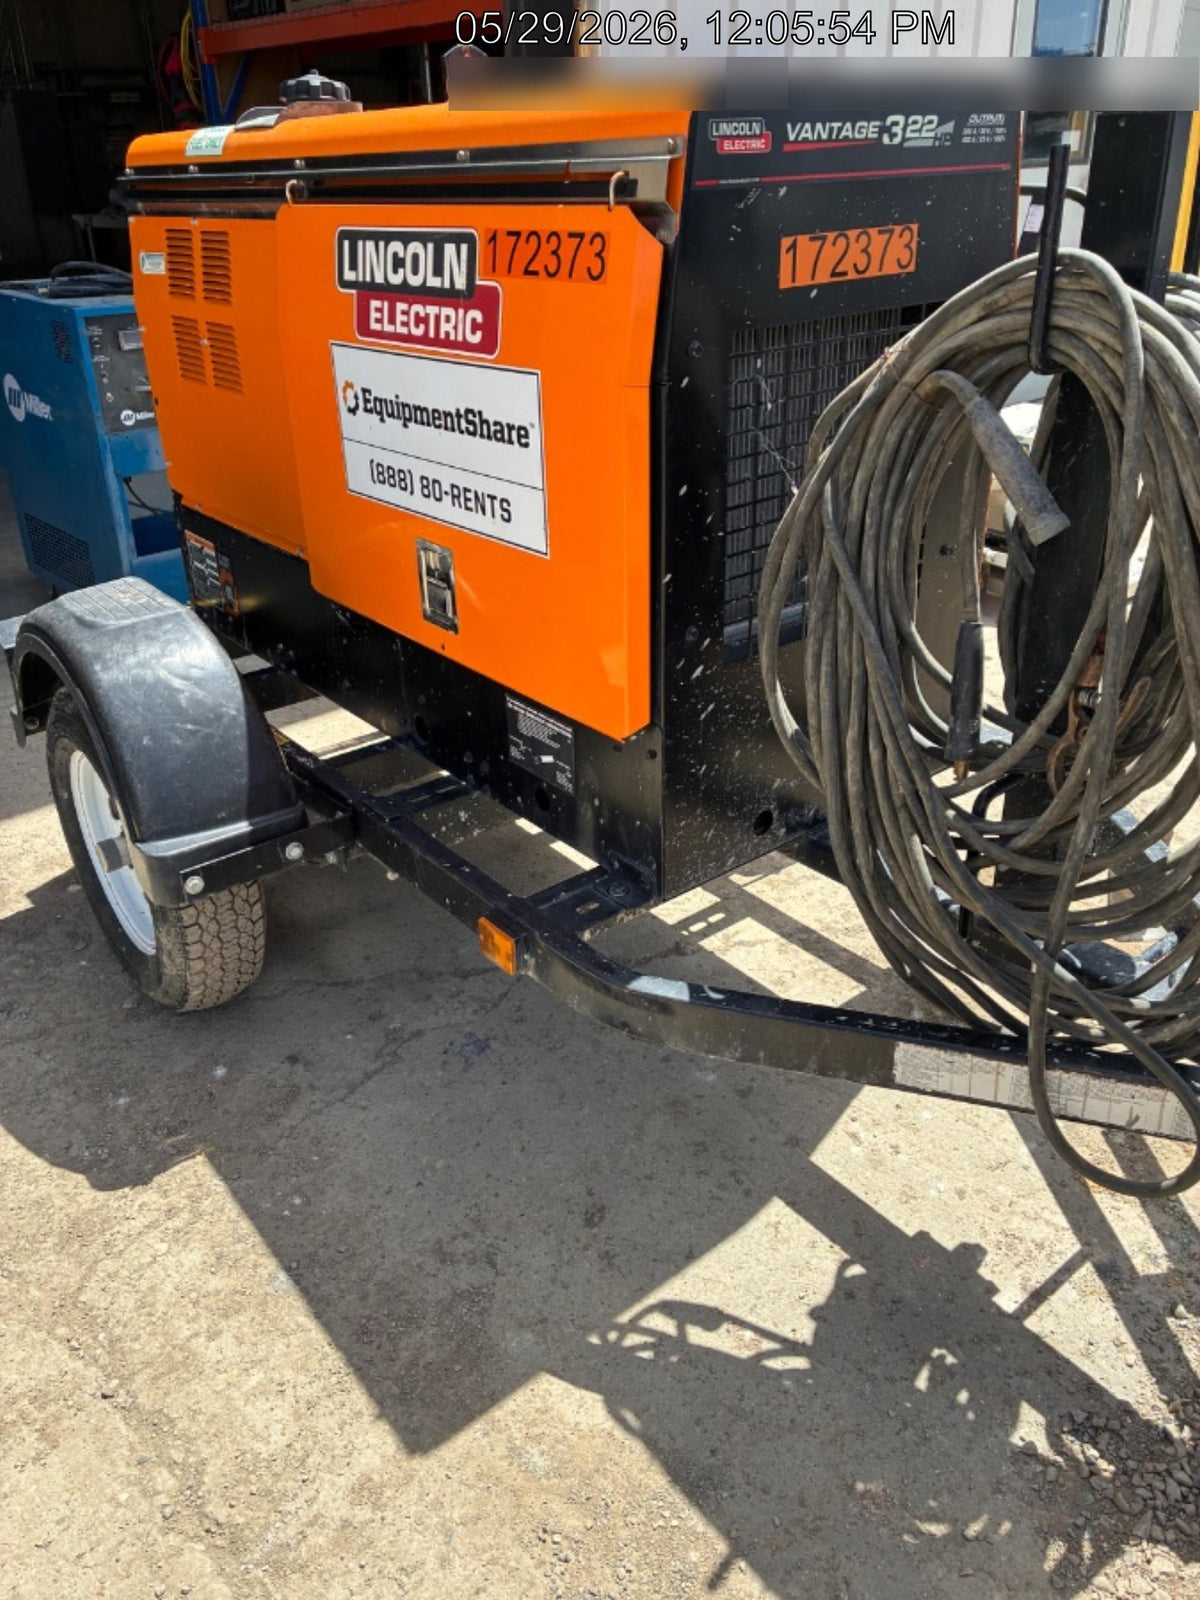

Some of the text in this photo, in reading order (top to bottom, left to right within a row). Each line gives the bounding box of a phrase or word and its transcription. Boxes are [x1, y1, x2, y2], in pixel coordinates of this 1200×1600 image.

[712, 122, 761, 136] LINCOLN
[723, 138, 766, 150] ELECTRIC
[787, 121, 881, 141] VANTAGE
[883, 114, 939, 145] 322
[342, 239, 469, 290] LINCOLN
[487, 230, 606, 281] 172373
[785, 225, 914, 283] 172373
[369, 299, 483, 344] ELECTRIC
[361, 387, 530, 448] EquipmentShare
[369, 458, 512, 523] (888) 80-RENTS
